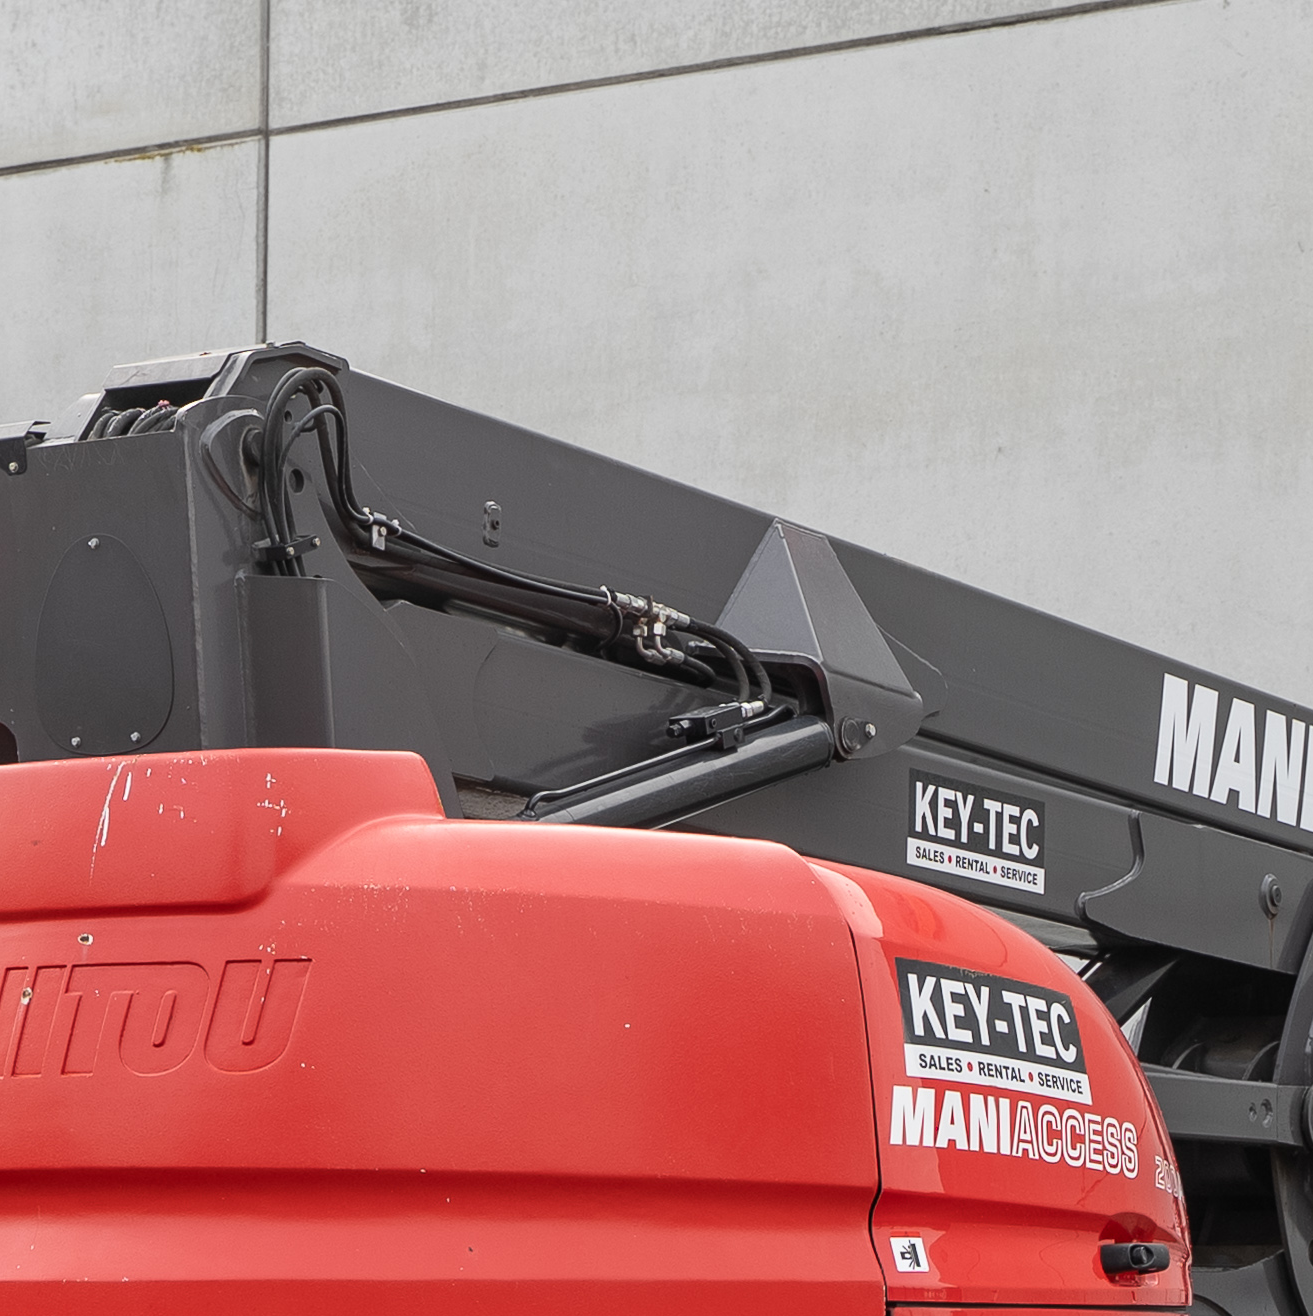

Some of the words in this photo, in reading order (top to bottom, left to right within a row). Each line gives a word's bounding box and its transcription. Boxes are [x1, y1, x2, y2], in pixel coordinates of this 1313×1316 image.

[914, 781, 1040, 860] KEY-TEC
[915, 846, 945, 864] SALES
[955, 855, 990, 875] RENTAL
[1000, 865, 1038, 885] SERVICE
[907, 973, 1078, 1064] KEY-TEC
[918, 1053, 963, 1073] SALES
[977, 1061, 1026, 1083] RENTAL
[1037, 1072, 1084, 1095] SERVICE
